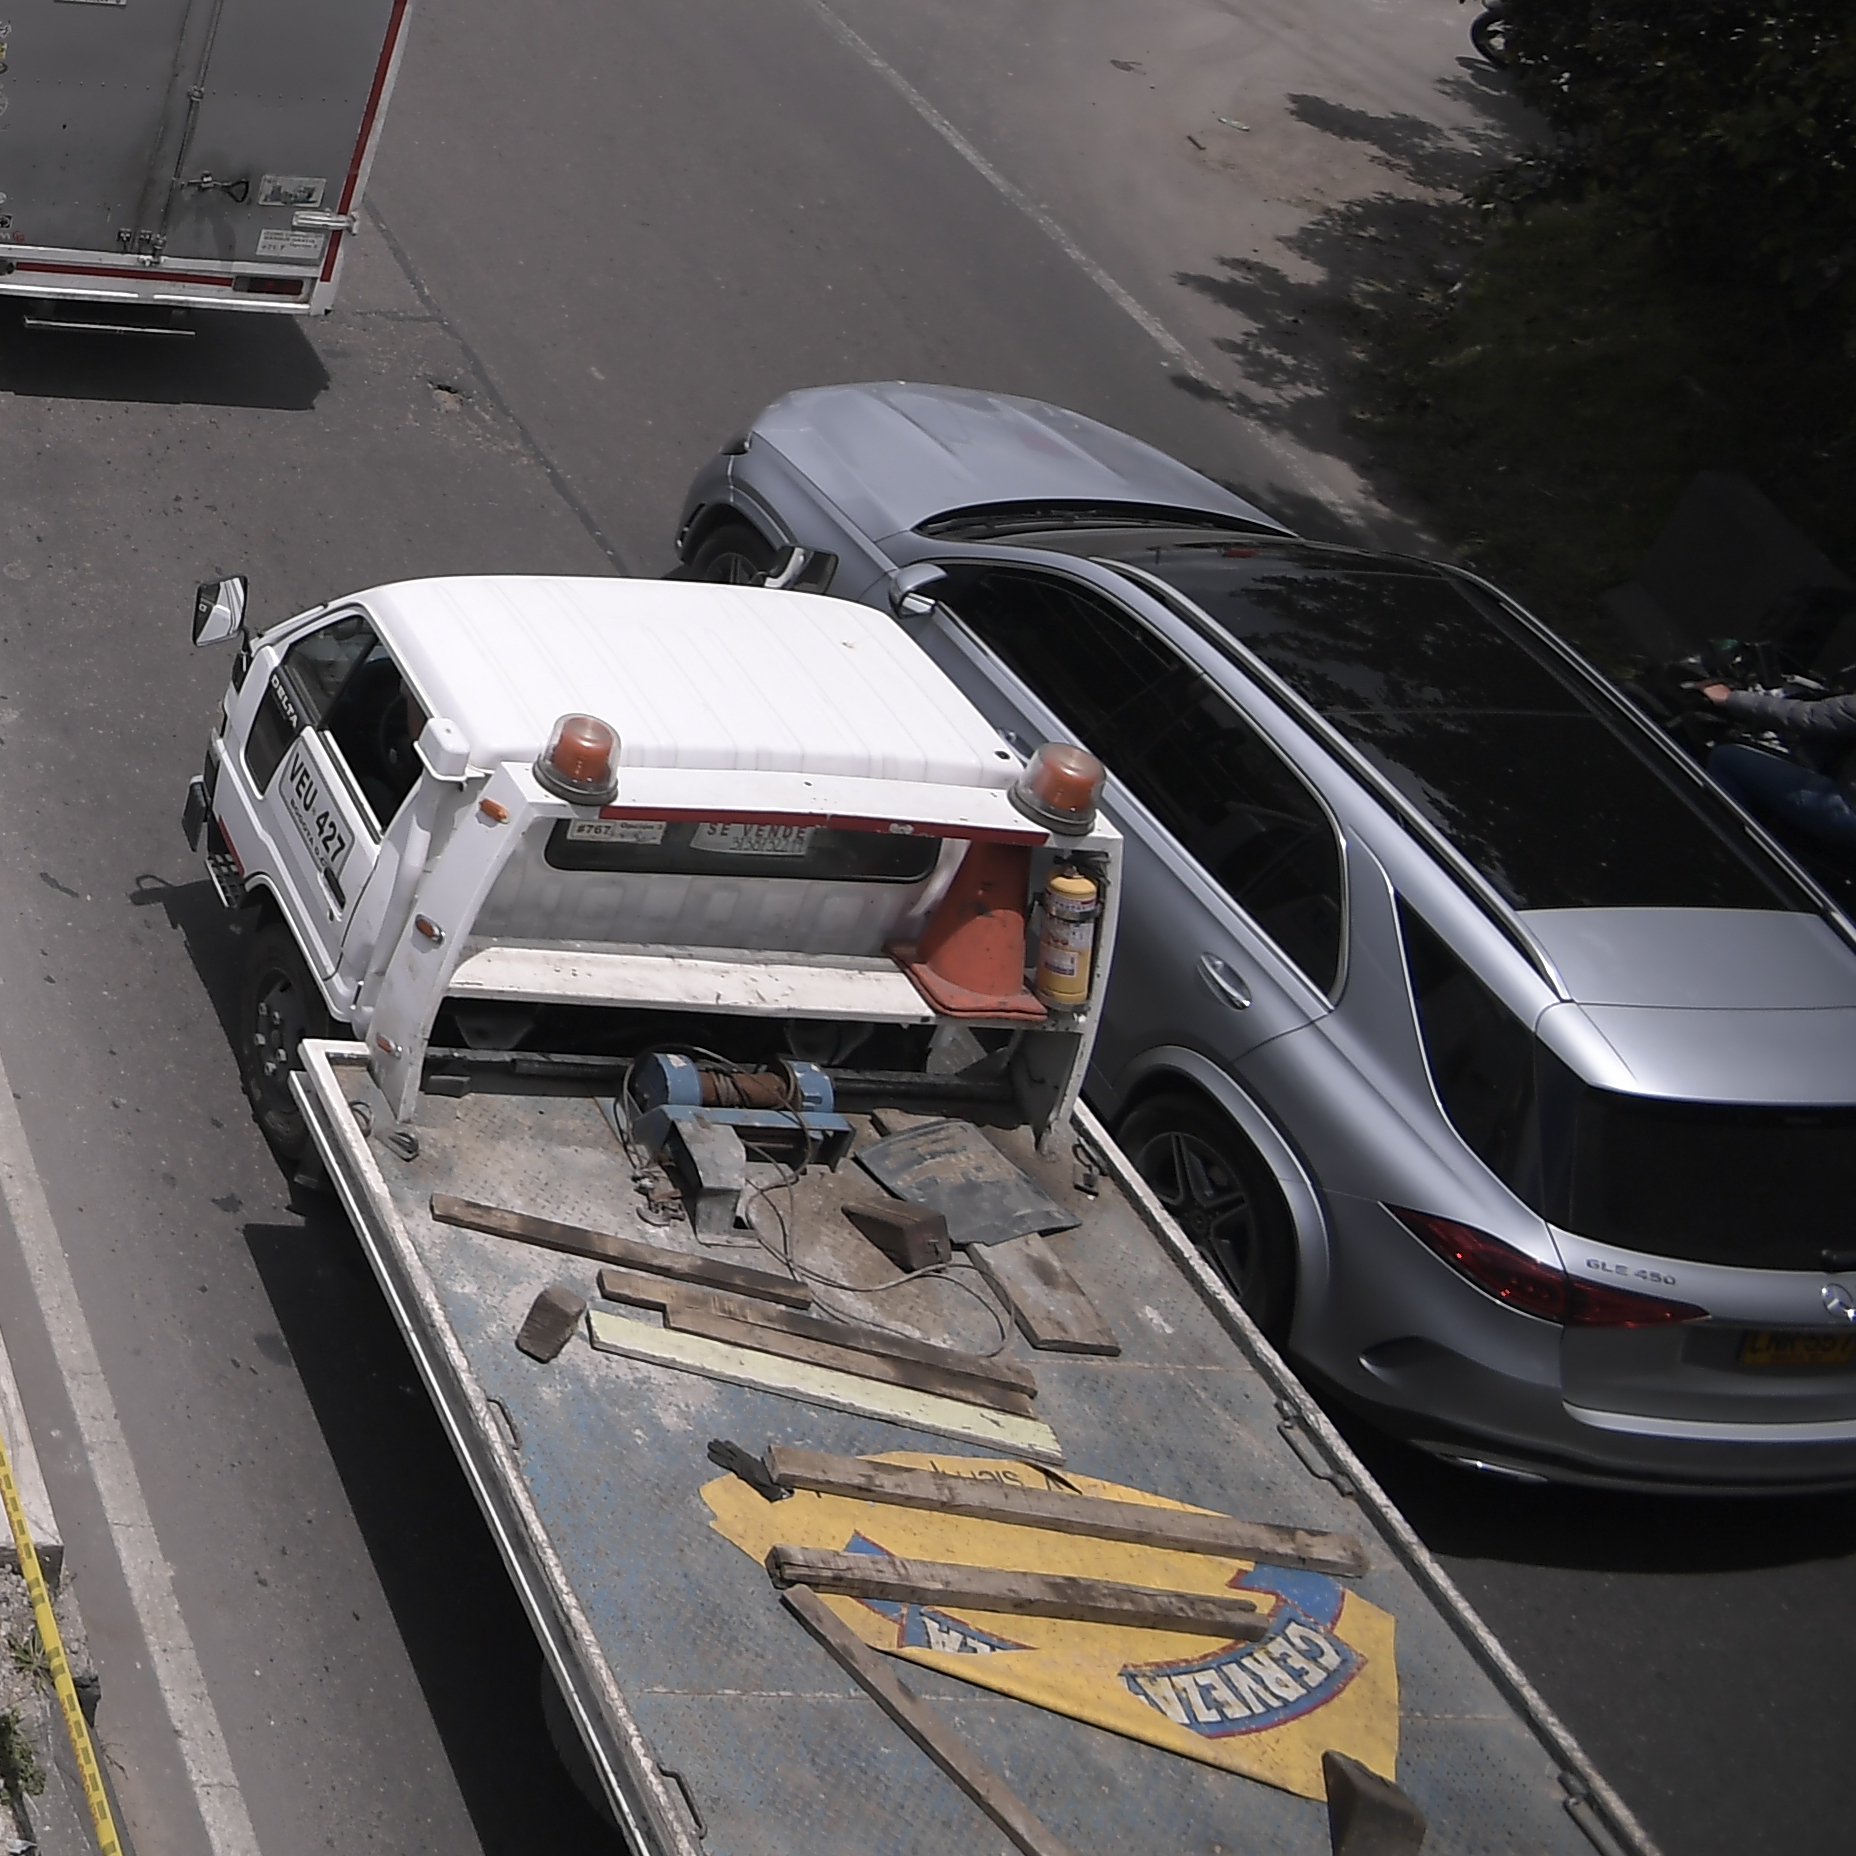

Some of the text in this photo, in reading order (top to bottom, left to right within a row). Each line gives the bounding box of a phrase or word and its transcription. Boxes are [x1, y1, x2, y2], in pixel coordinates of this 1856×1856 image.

[270, 674, 300, 729] DELTA
[706, 823, 807, 840] SE VENDE
[1585, 1258, 1677, 1286] GLE 450
[1136, 1620, 1343, 1726] CERVEZA
